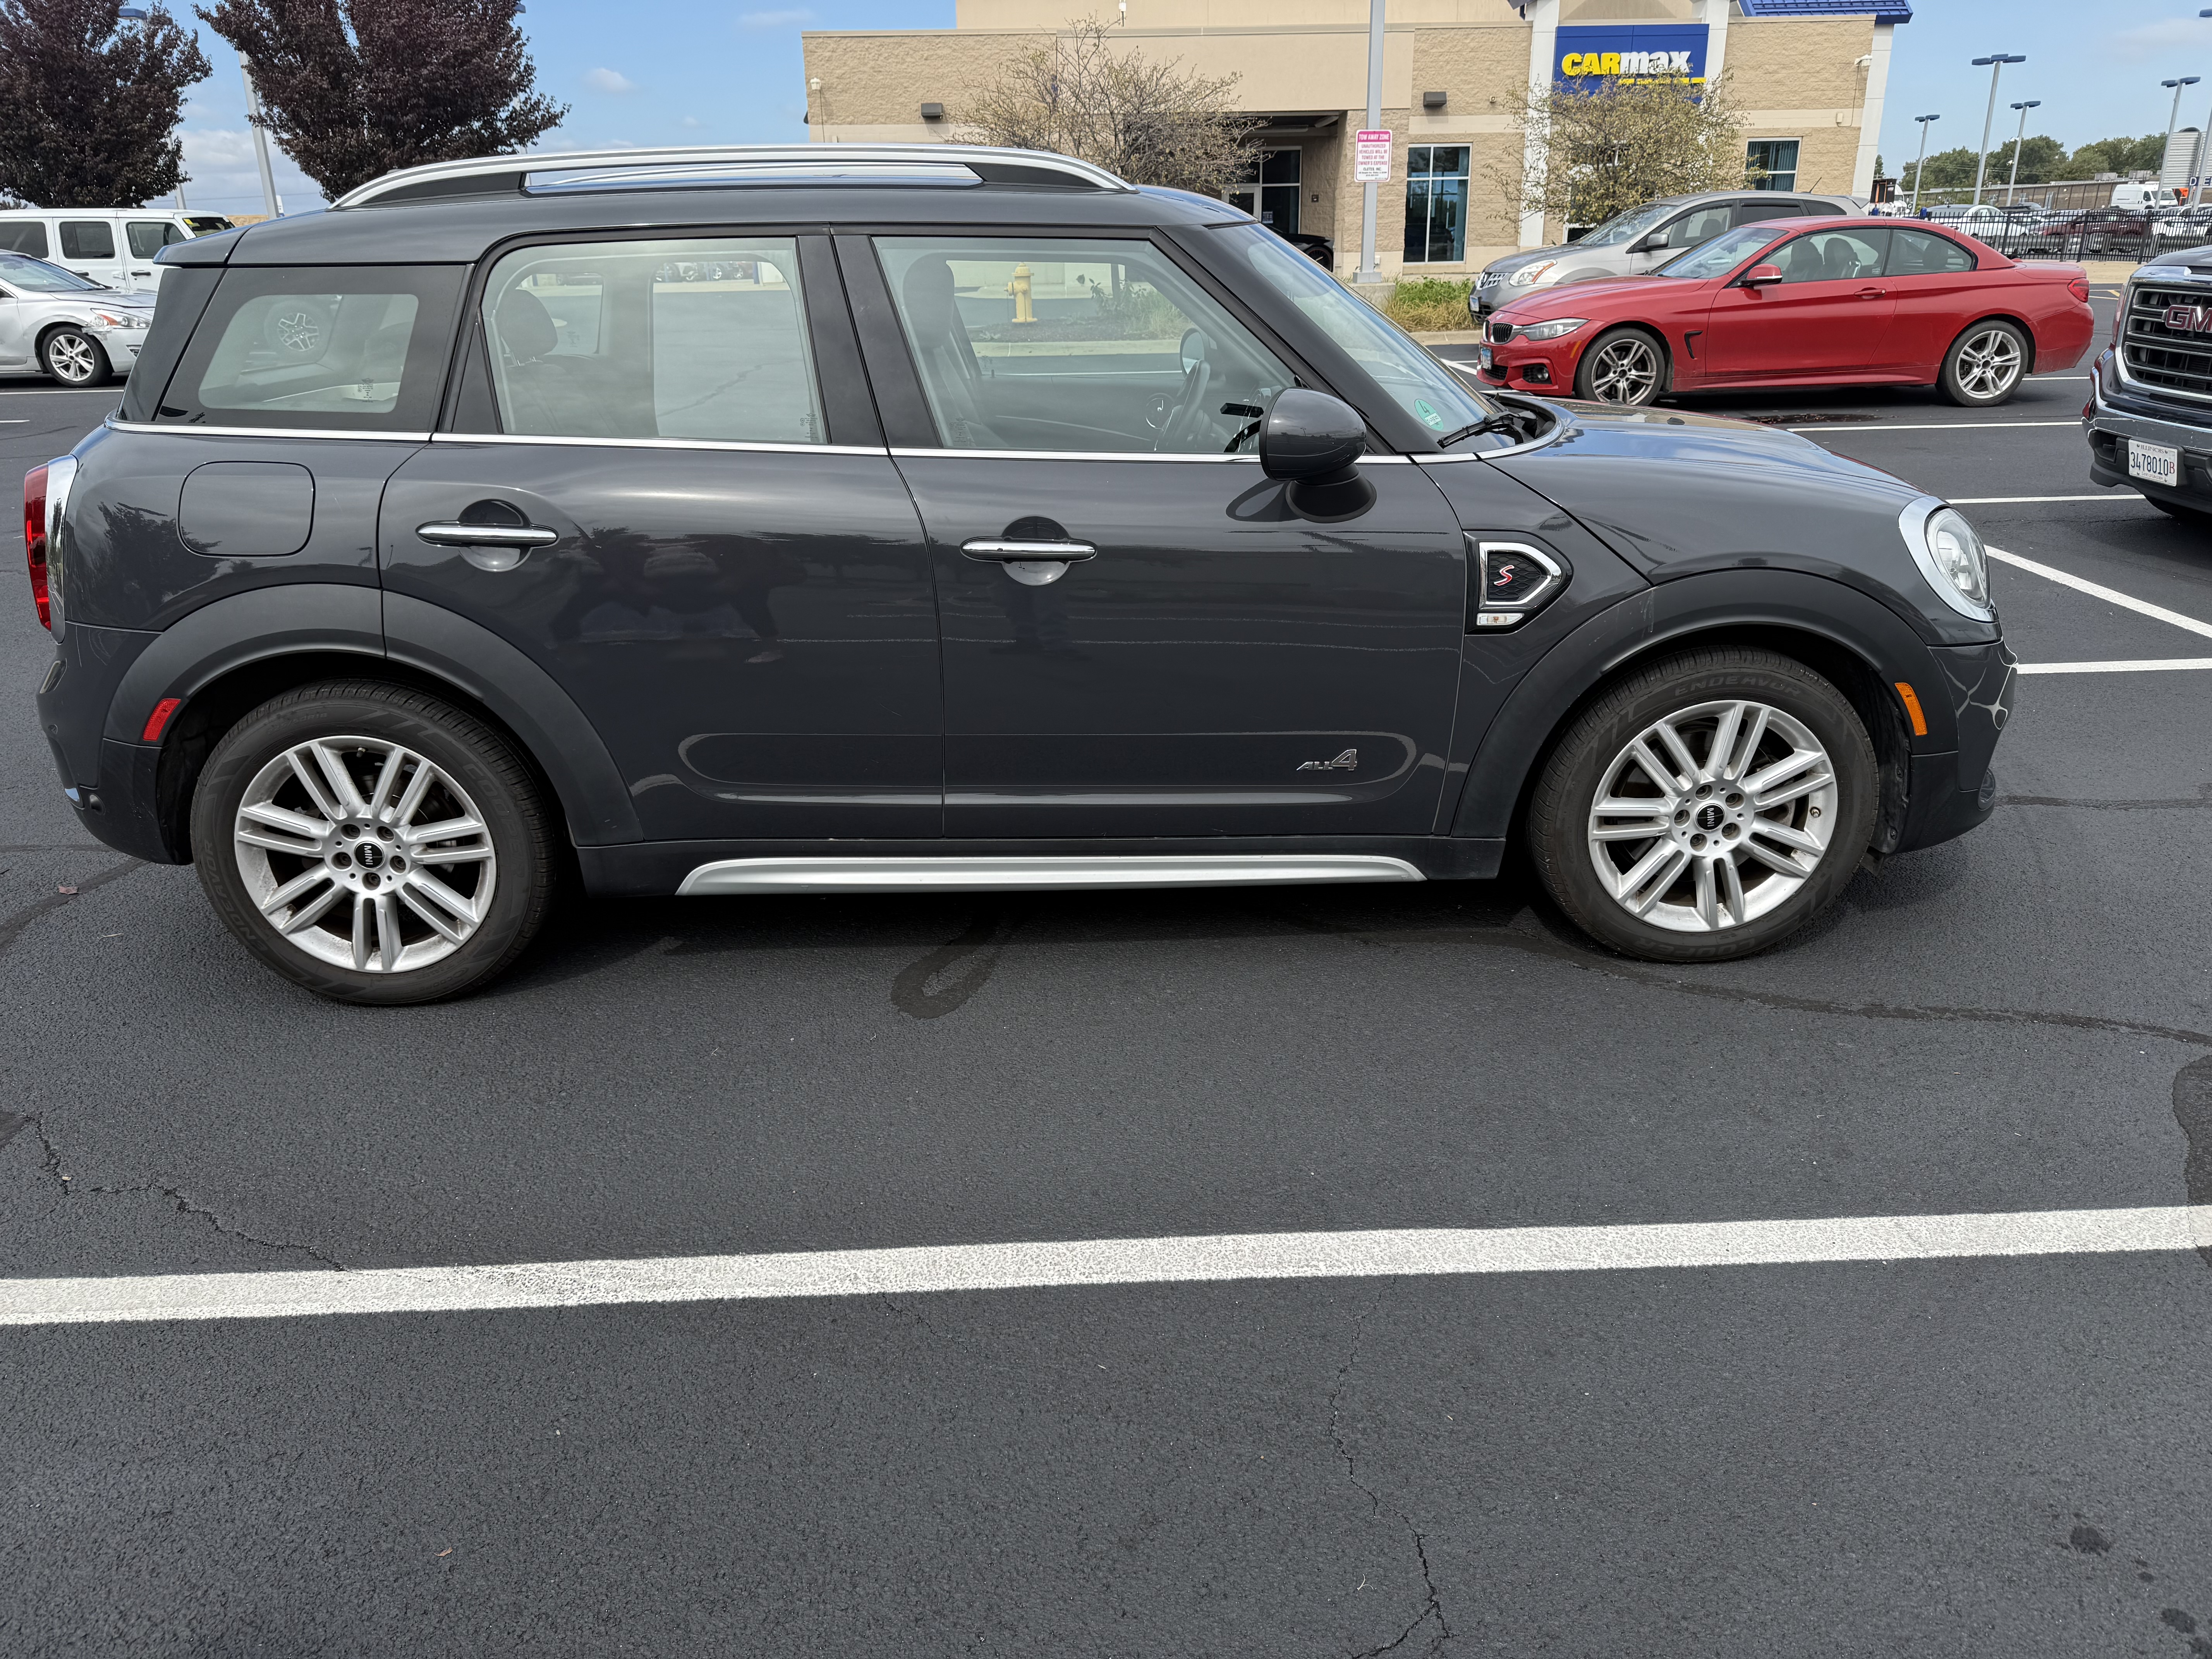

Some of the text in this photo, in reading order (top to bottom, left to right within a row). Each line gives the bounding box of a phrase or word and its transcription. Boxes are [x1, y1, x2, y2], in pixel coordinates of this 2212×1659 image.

[2141, 445, 2164, 454] ILLINOIS
[1494, 565, 1515, 586] S
[1675, 676, 1802, 697] ENDEAVOR
[1296, 749, 1358, 771] ALL4
[463, 762, 526, 878] COOPER
[1707, 807, 1715, 827] MINI
[364, 845, 373, 865] MINI
[204, 838, 270, 951] ENDEAVOR
[1633, 936, 1756, 958] COOPER
